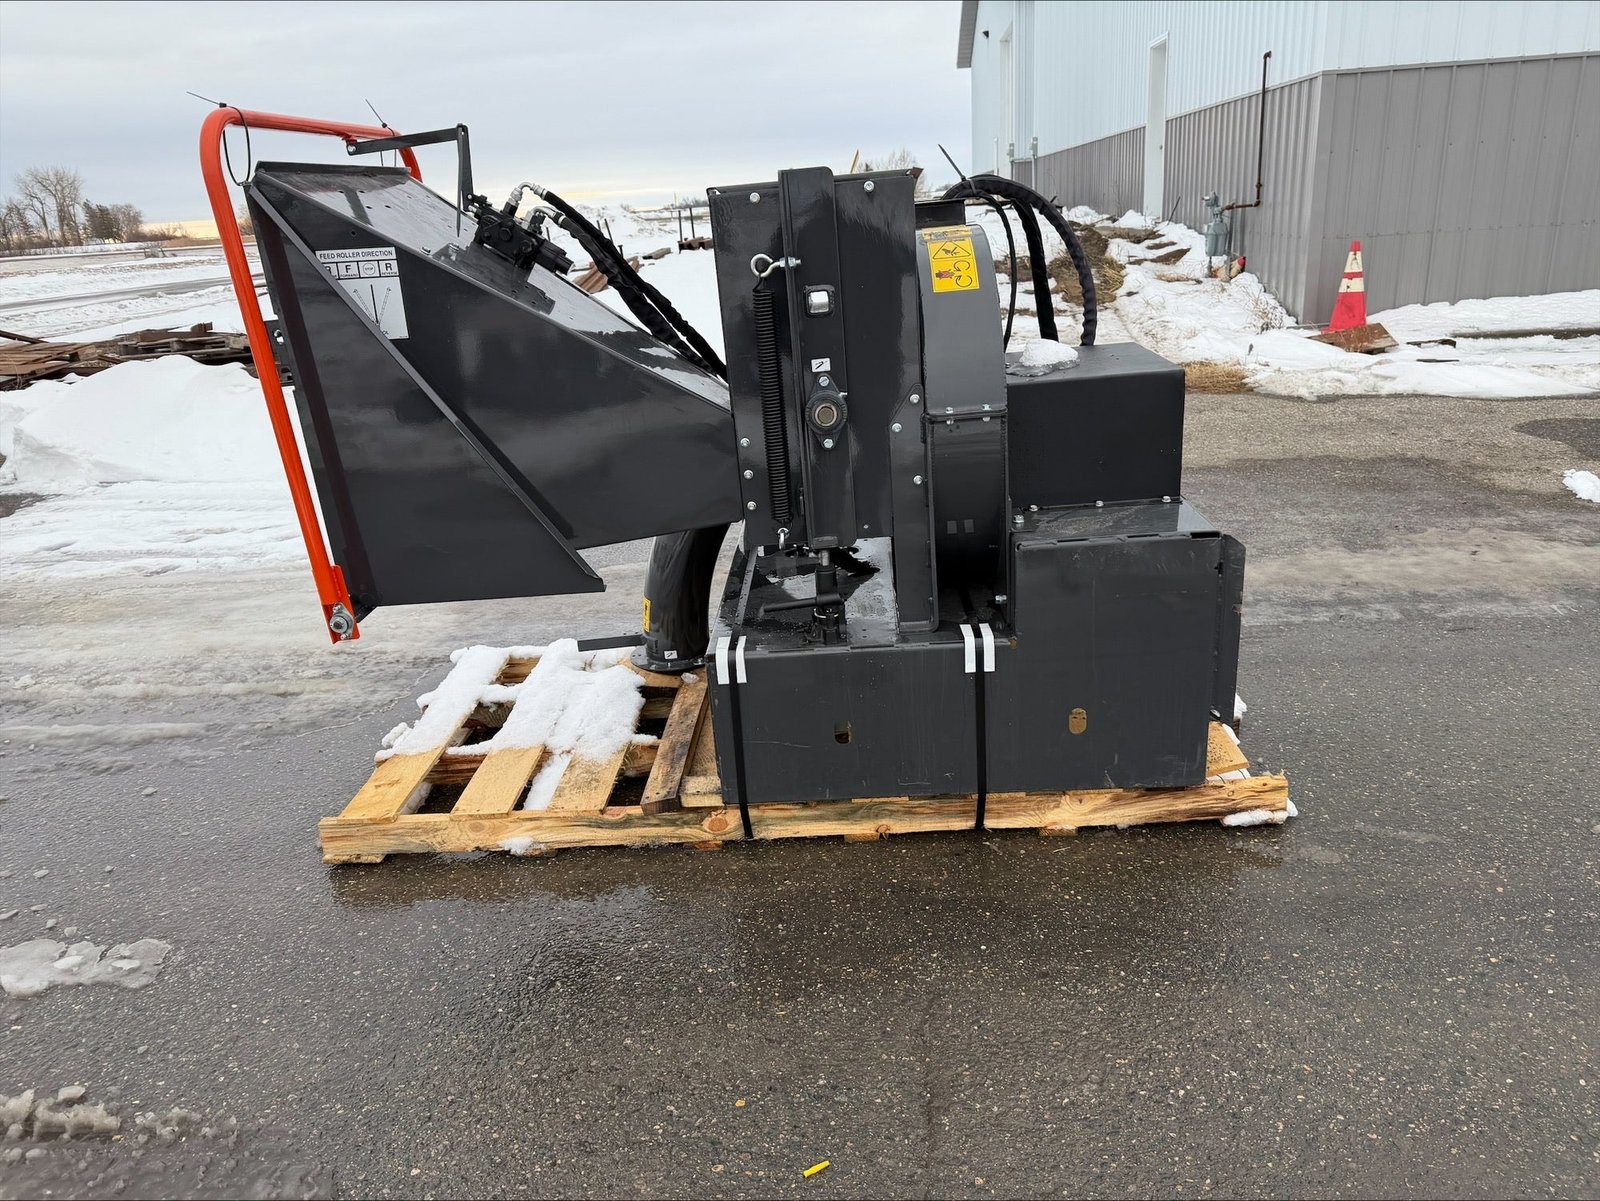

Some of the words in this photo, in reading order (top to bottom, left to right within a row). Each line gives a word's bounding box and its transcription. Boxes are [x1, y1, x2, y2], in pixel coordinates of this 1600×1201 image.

[336, 251, 360, 259] ROLLER
[361, 250, 393, 258] DIRECTION
[345, 264, 351, 273] F
[385, 263, 393, 271] R
